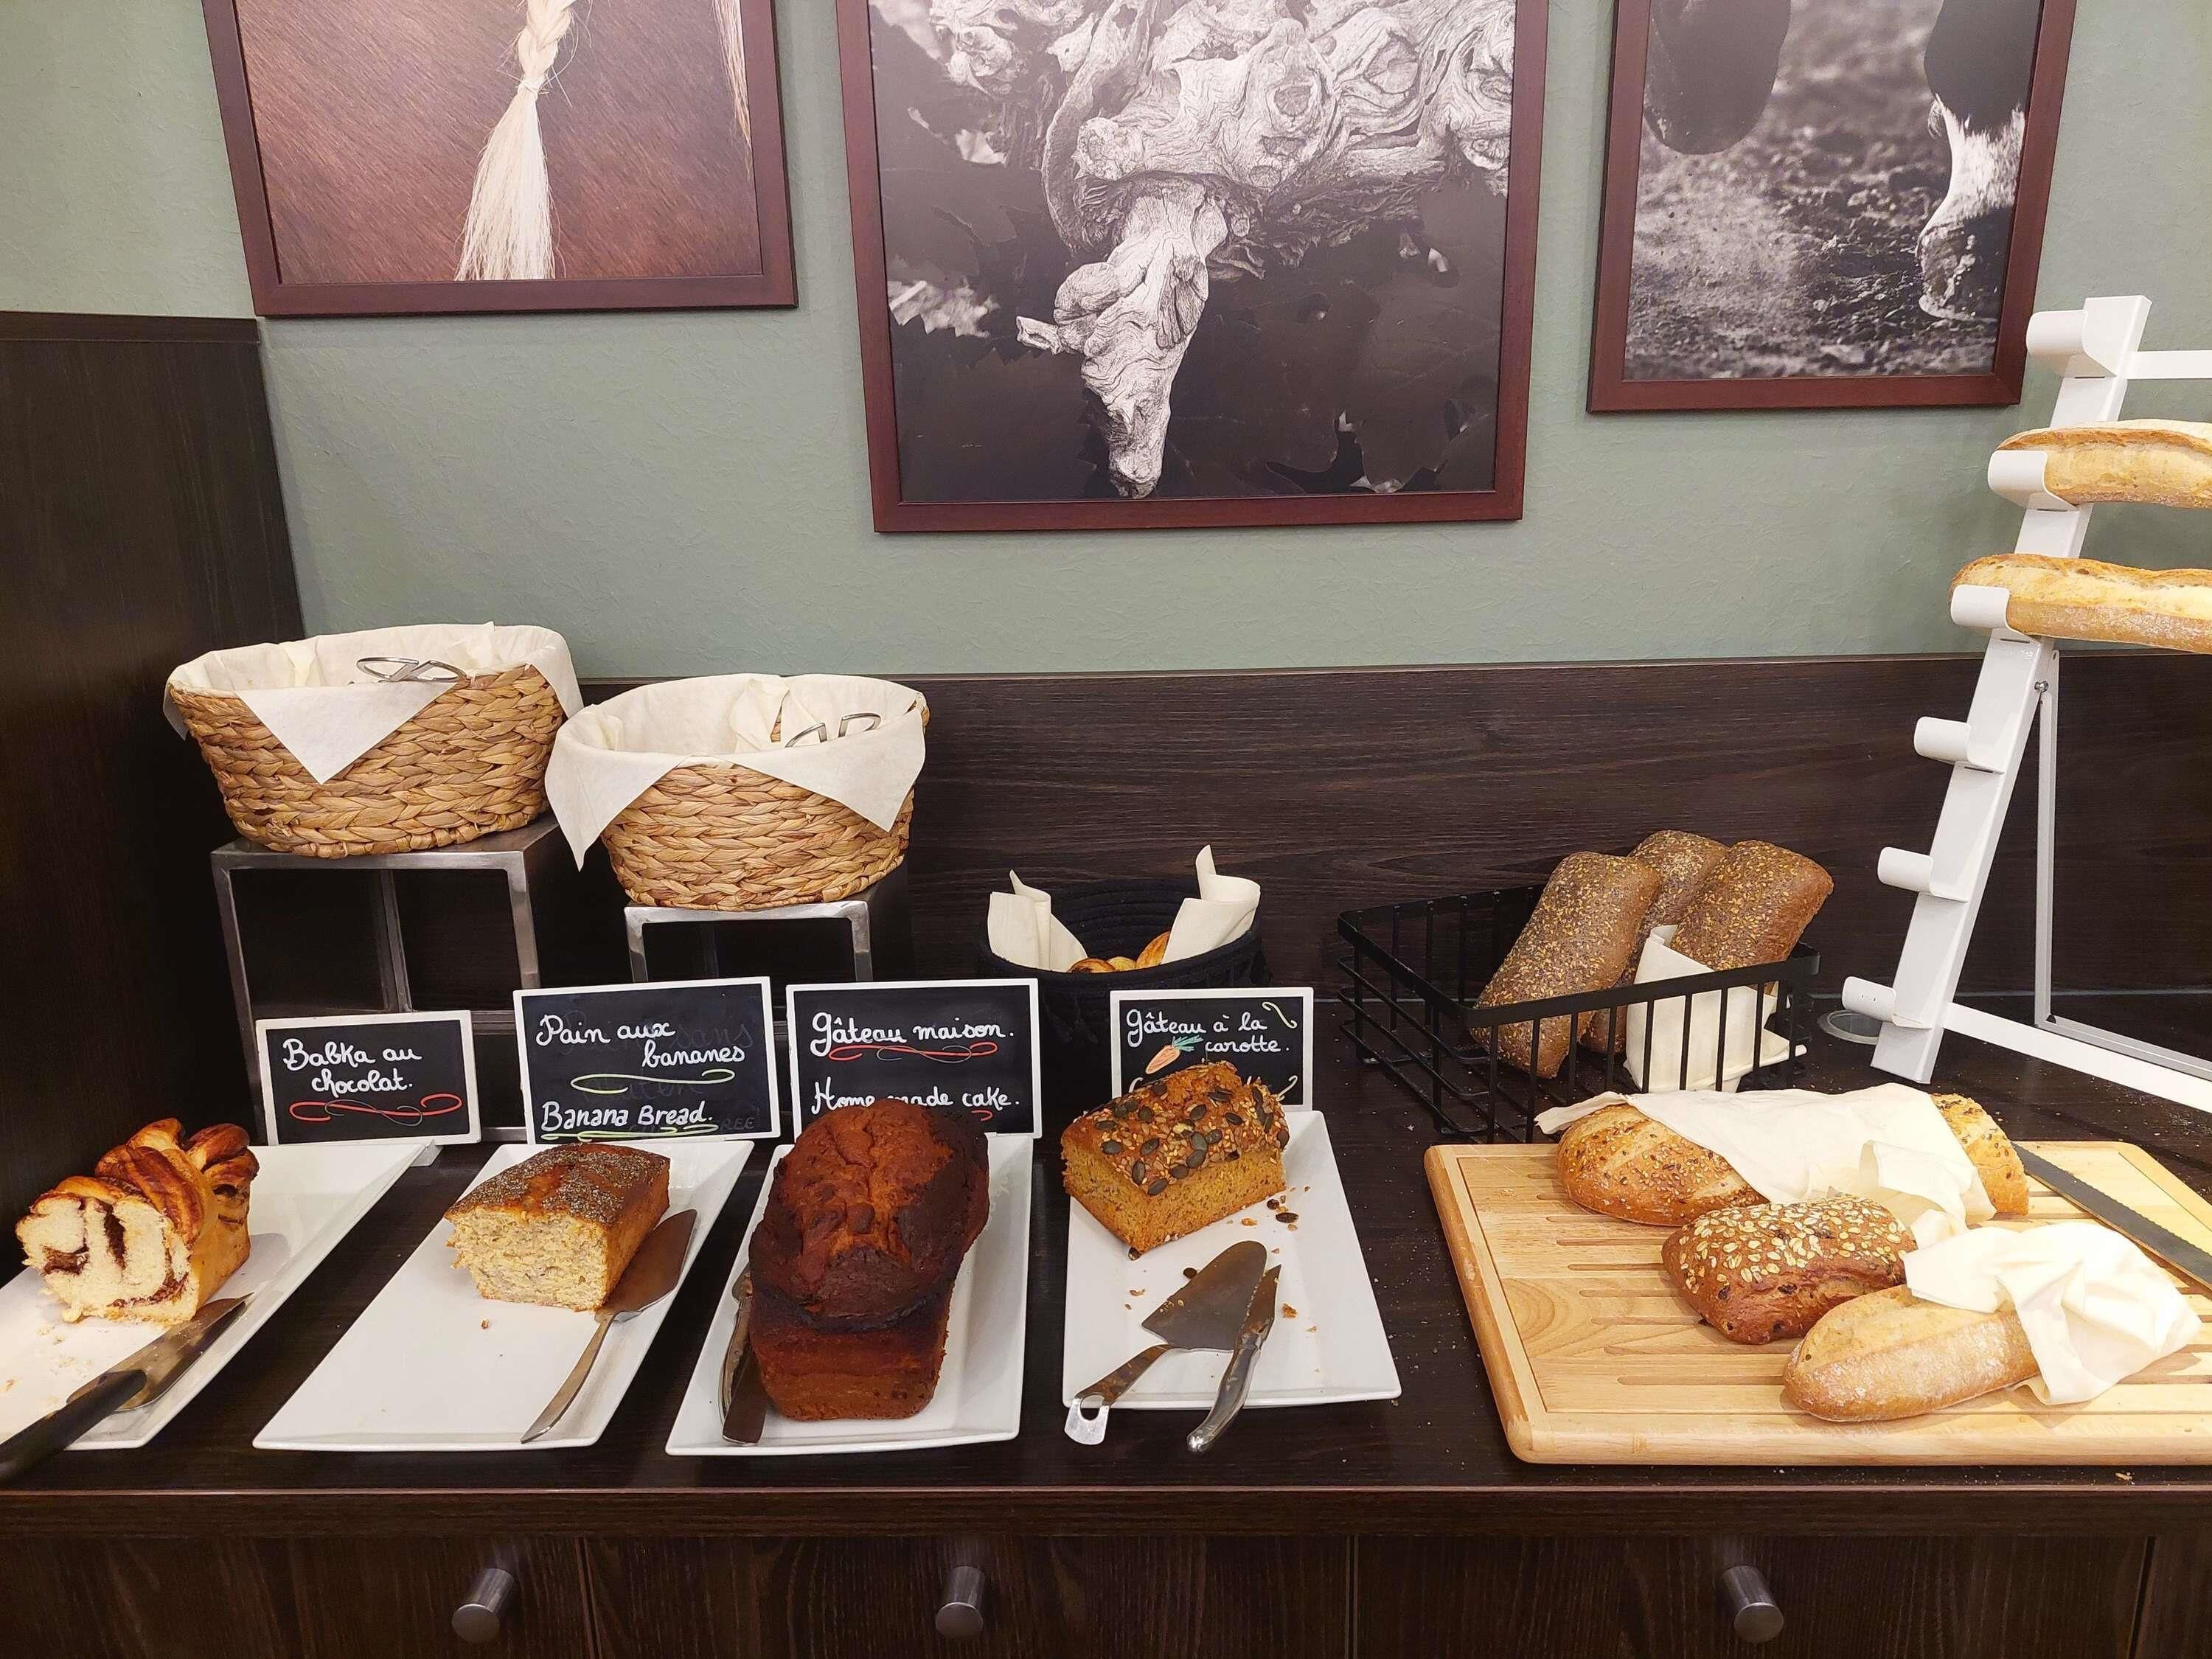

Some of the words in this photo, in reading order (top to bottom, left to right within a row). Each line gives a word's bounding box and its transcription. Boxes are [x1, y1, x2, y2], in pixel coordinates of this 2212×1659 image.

[535, 1014, 611, 1046] Pain
[616, 1020, 677, 1040] aux
[912, 1017, 1014, 1040] maison.
[1213, 1014, 1229, 1033] à
[1238, 1011, 1268, 1032] la
[382, 1048, 422, 1062] au
[641, 1039, 745, 1068] bananes
[1205, 1034, 1290, 1053] carotte.
[311, 1067, 413, 1099] chocolat.
[540, 1101, 629, 1132] Banana
[637, 1100, 714, 1127] Bread.
